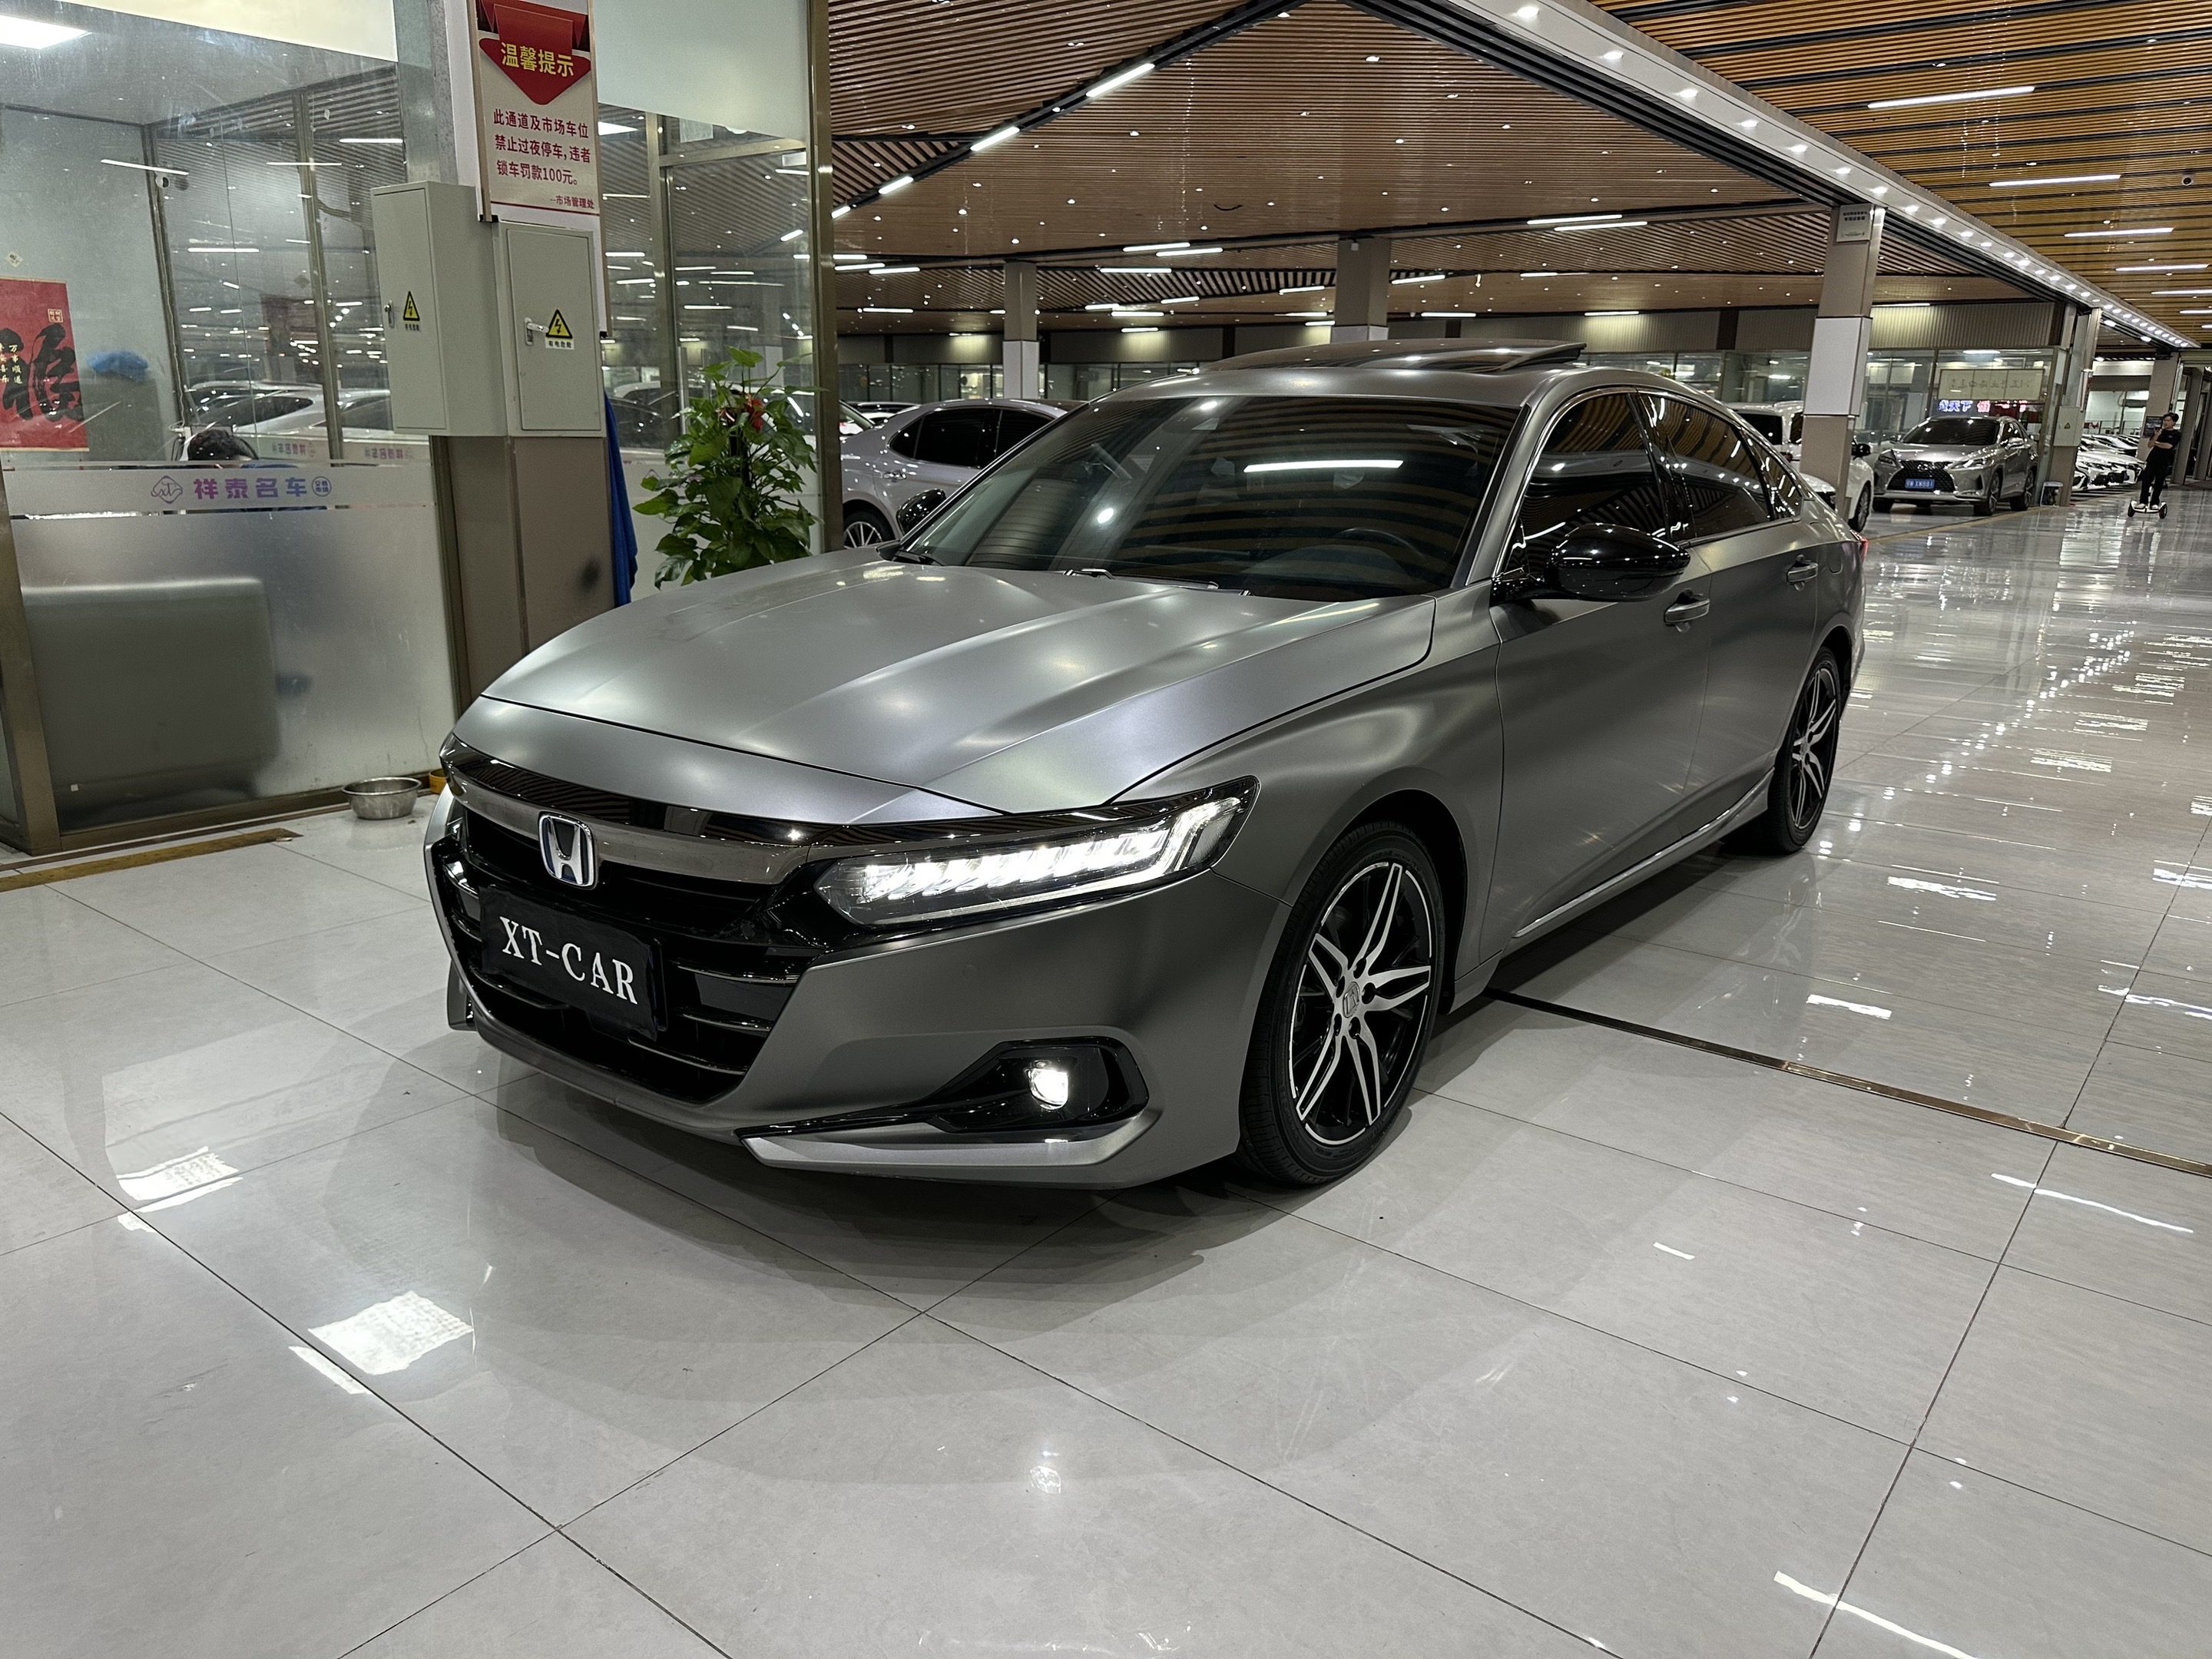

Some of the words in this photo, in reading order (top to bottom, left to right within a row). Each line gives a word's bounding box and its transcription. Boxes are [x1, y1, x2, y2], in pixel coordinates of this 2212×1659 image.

[500, 41, 575, 78] 温馨提示
[493, 108, 589, 139] 此通道及市场车位
[495, 134, 591, 164] 禁止过夜停车，违者
[496, 159, 578, 186] 锁车罚款100元。
[193, 477, 308, 499] 祥泰名车
[499, 916, 638, 1005] XT-CAR
